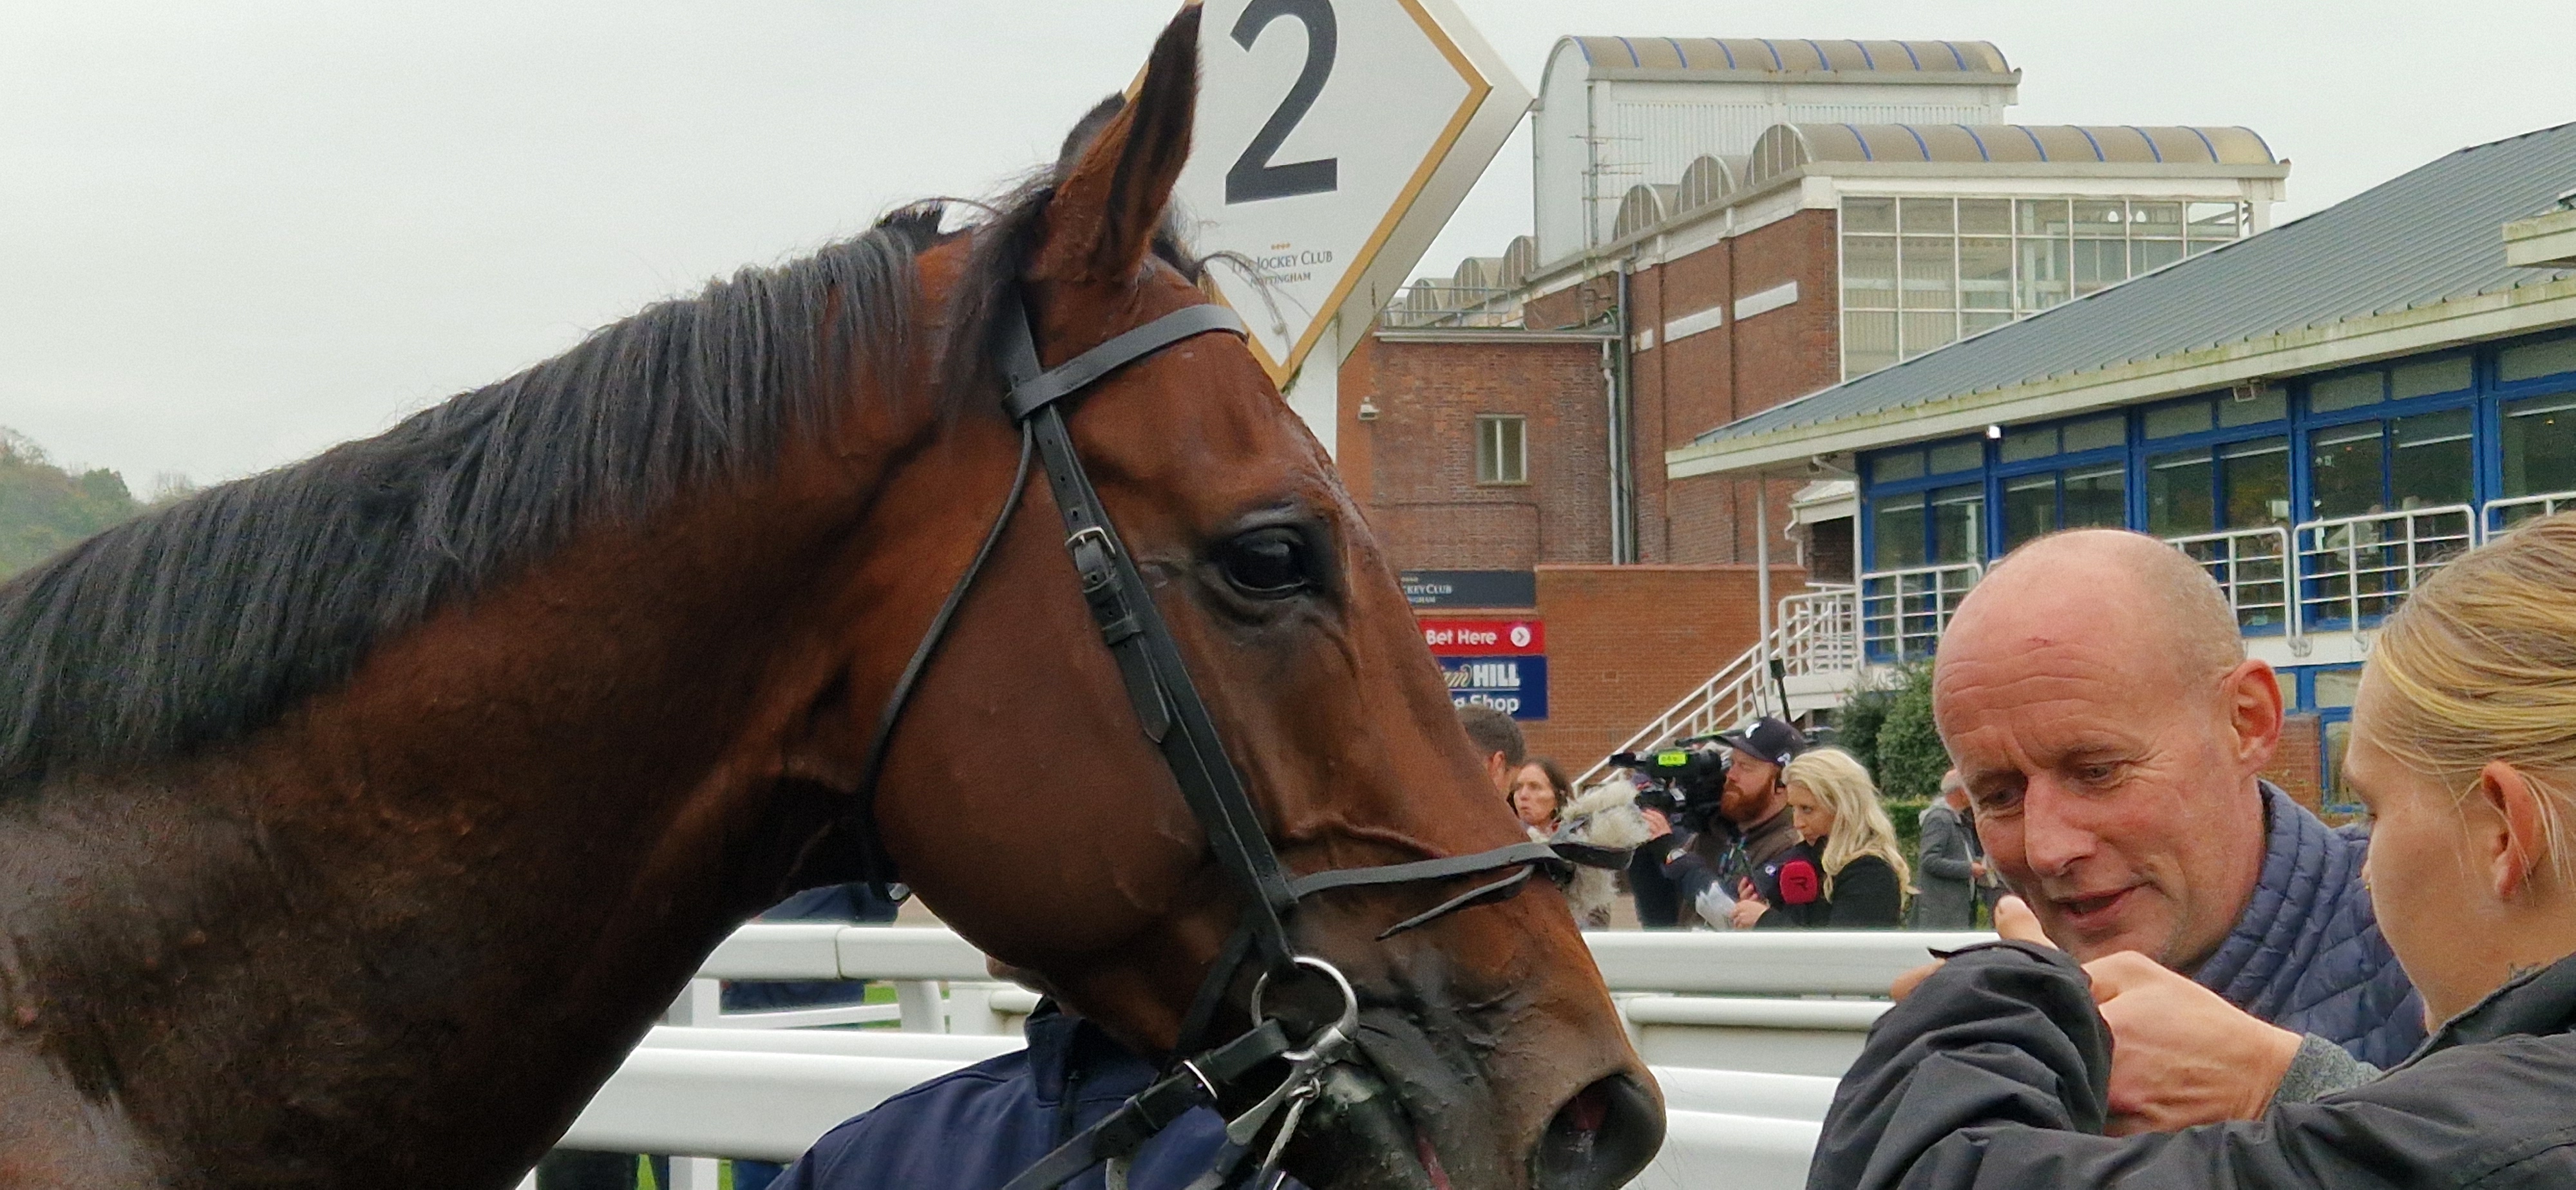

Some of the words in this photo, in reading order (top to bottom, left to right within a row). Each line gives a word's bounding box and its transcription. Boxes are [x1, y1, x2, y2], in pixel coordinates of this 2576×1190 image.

[1226, 0, 1338, 205] 2
[1257, 254, 1298, 272] JOCKEY
[1301, 250, 1333, 265] CLUB
[1426, 583, 1452, 594] CLUB
[1426, 630, 1454, 645] Bet
[1457, 629, 1497, 645] Here
[1473, 664, 1520, 687] HILL
